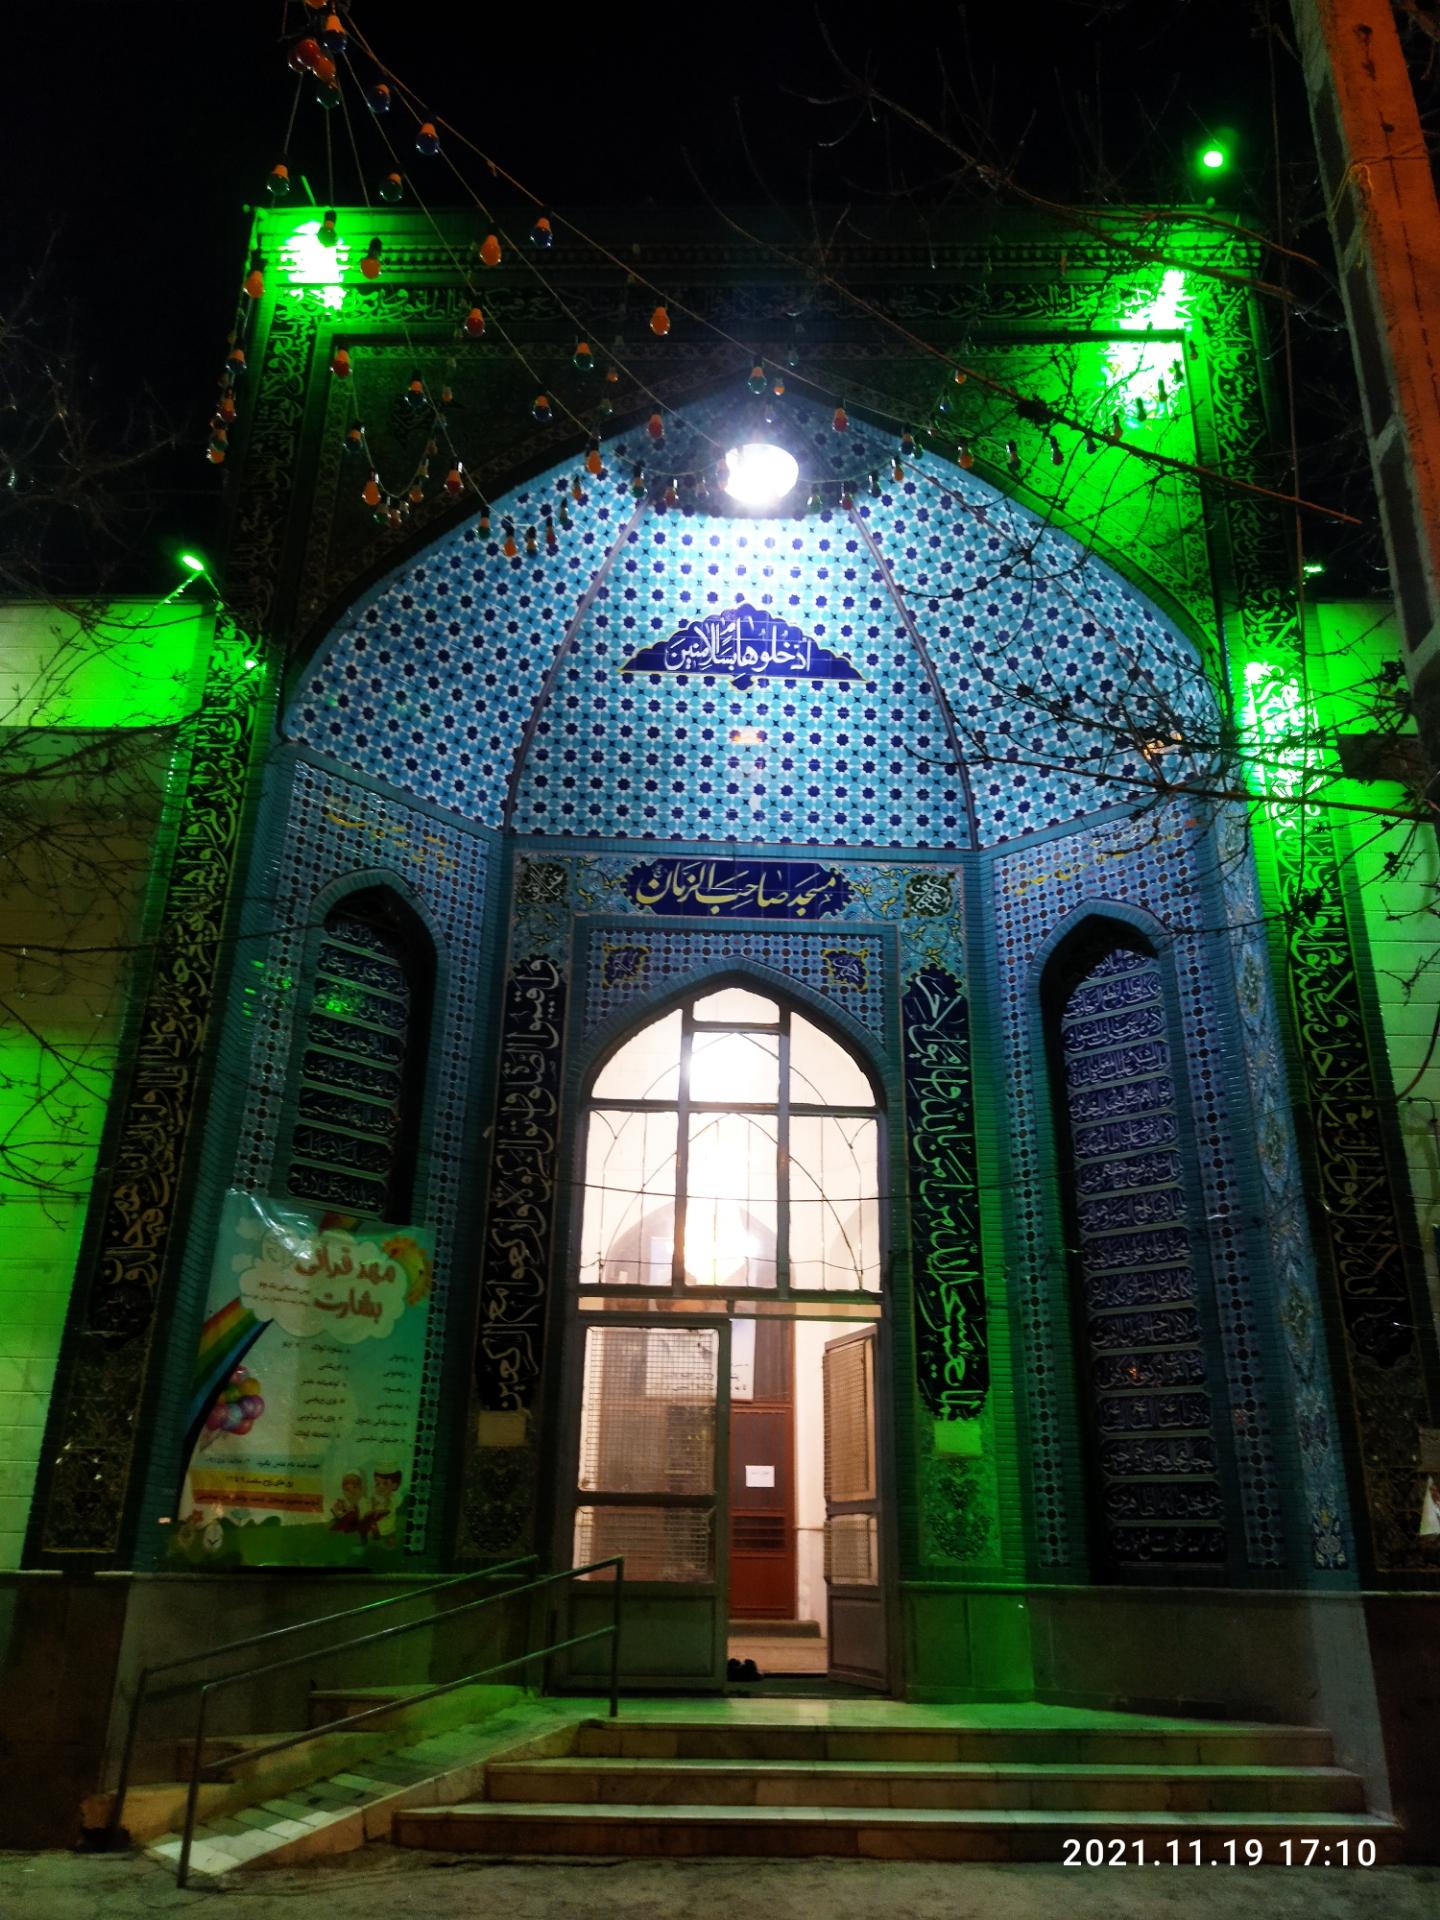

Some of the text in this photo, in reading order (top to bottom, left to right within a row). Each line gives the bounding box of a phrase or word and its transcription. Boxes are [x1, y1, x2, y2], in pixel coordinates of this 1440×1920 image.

[636, 862, 836, 916] مسجد صاحب الزمان
[357, 1261, 396, 1285] مهد
[314, 1288, 383, 1323] بشارت
